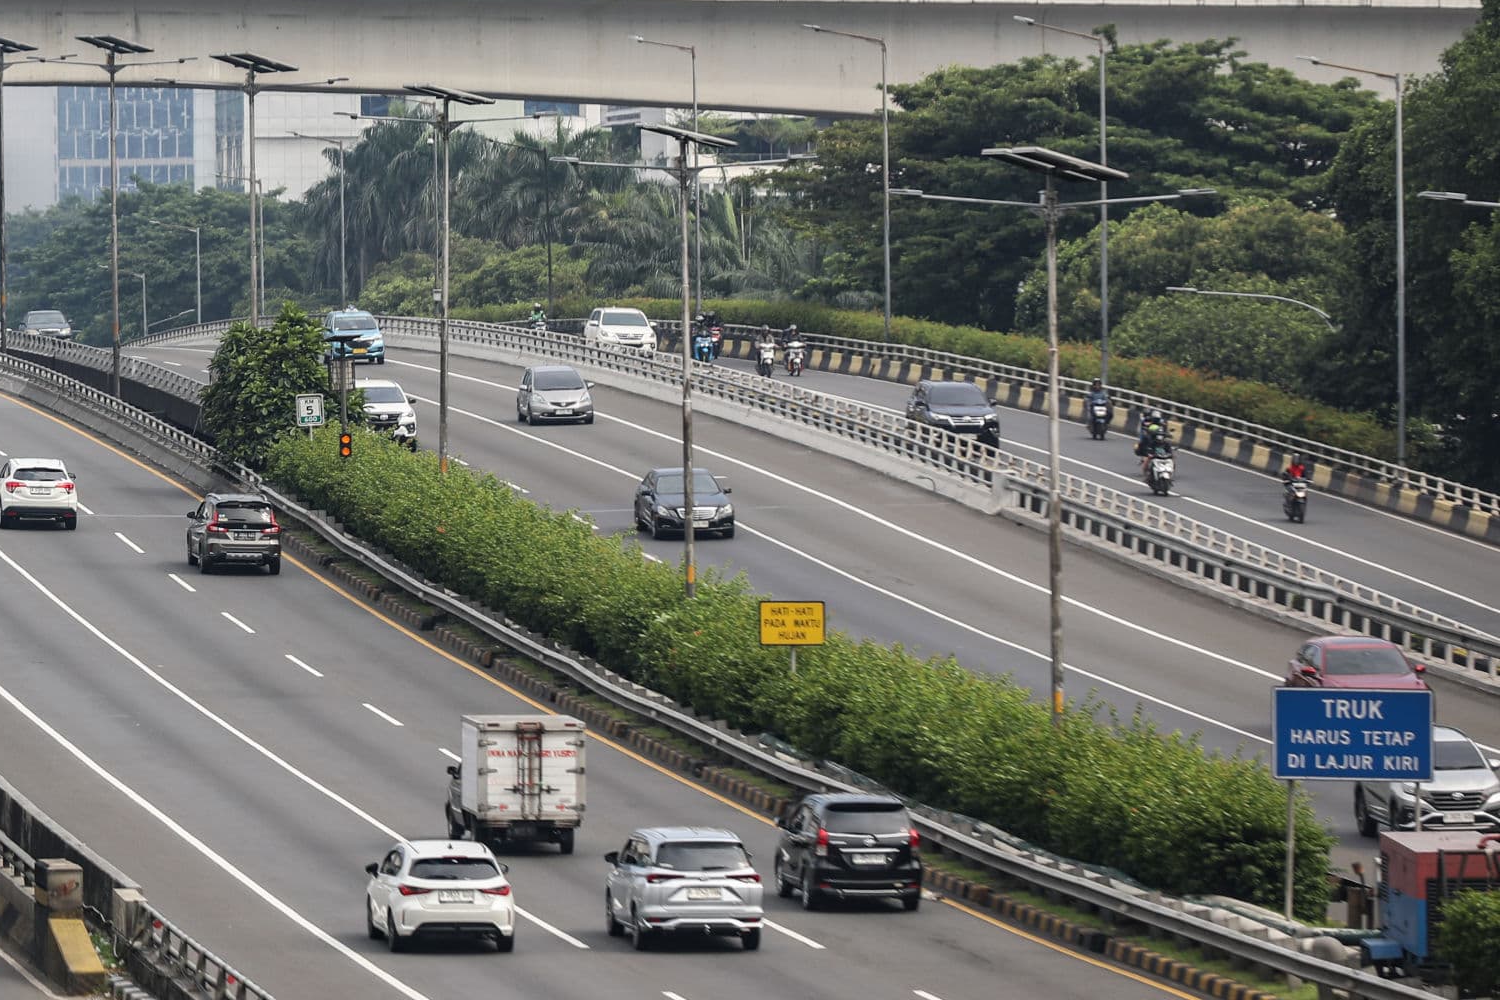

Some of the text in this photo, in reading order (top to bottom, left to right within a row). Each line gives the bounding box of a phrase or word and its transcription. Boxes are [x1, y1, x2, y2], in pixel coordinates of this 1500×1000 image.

[306, 405, 314, 415] 5
[771, 607, 814, 616] HATI-HATI
[764, 619, 787, 628] PADA
[779, 631, 807, 640] HUJAN
[1321, 698, 1384, 720] TRUK
[1290, 729, 1416, 746] HARUS TETAP
[1287, 753, 1420, 771] DI LAJUR KIRI
